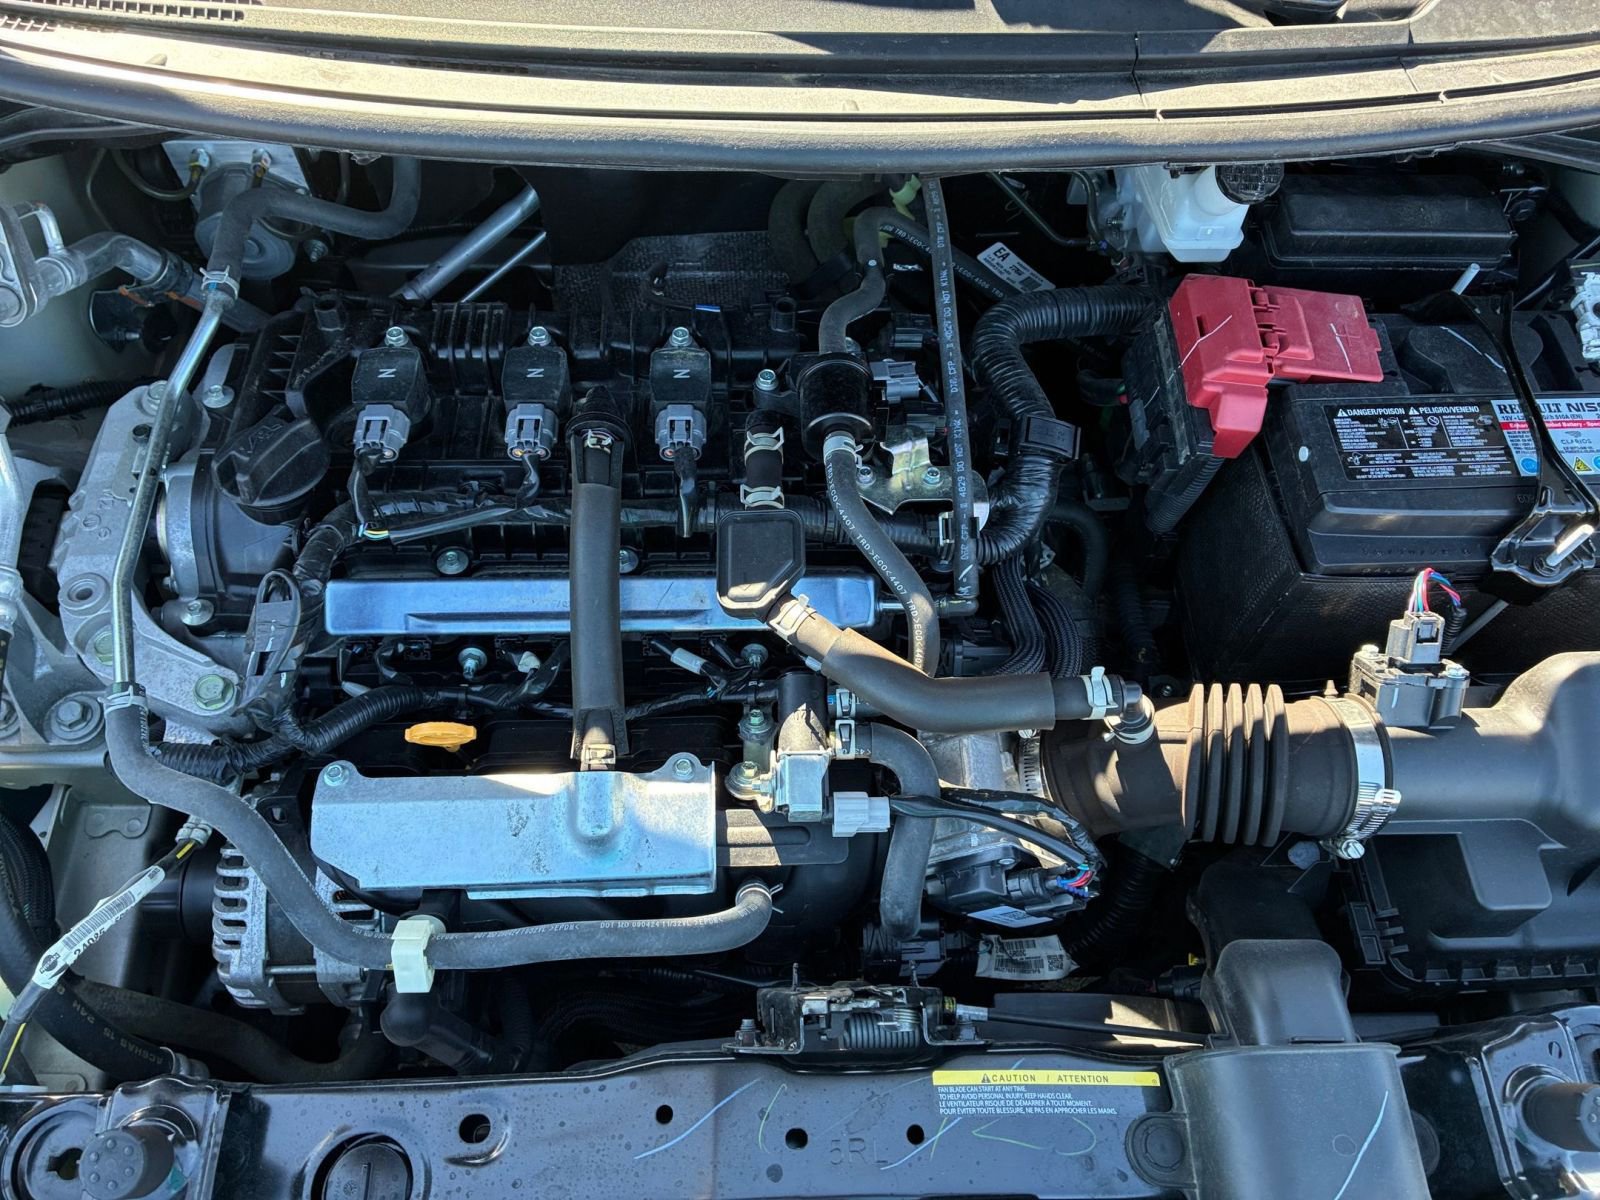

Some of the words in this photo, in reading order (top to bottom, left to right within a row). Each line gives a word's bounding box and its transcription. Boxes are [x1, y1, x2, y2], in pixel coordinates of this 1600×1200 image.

[993, 247, 1010, 261] EA
[942, 290, 951, 304] NOT
[1347, 407, 1405, 416] DANGER/POISON
[1419, 405, 1479, 414] PELIGRO/VENENO
[956, 460, 965, 472] DO
[957, 476, 967, 498] 4829
[991, 1074, 1037, 1082] CAUTION
[1057, 1075, 1109, 1083] ATTENTION
[940, 1107, 956, 1115] POUR
[1088, 1107, 1097, 1115] LES
